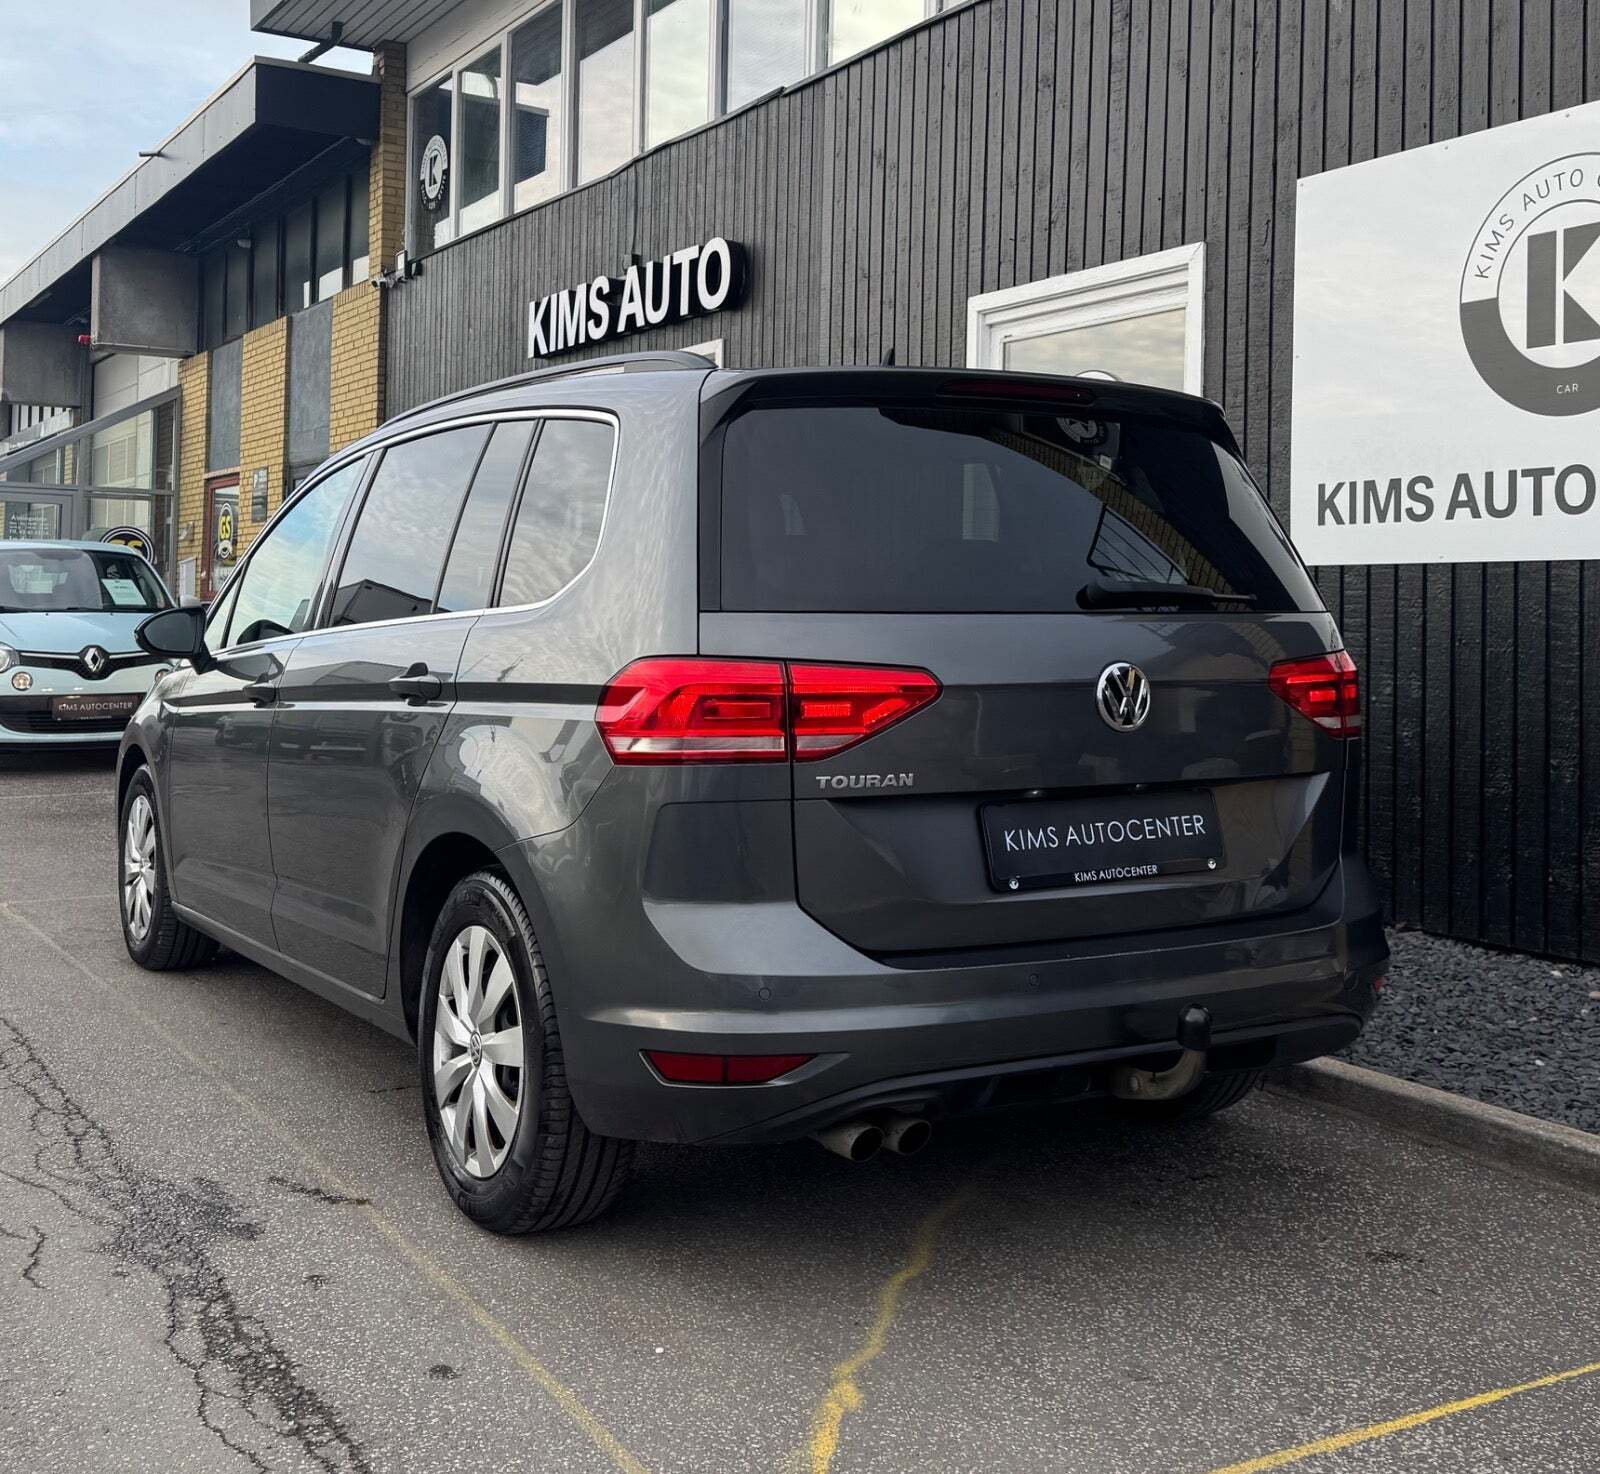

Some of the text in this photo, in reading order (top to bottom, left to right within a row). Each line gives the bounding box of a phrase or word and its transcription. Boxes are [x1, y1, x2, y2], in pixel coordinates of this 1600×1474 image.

[1474, 168, 1584, 279] KIMS AUTO
[528, 237, 731, 359] KIMS AUTO
[1556, 383, 1579, 394] CAR
[1317, 463, 1597, 526] KIMS AUTO
[80, 702, 133, 711] AUTOCENTER
[815, 773, 914, 789] TOURAN
[1004, 814, 1207, 852] KIMS AUTOCENTER
[1074, 865, 1158, 882] KIMS AUTOCENTER
